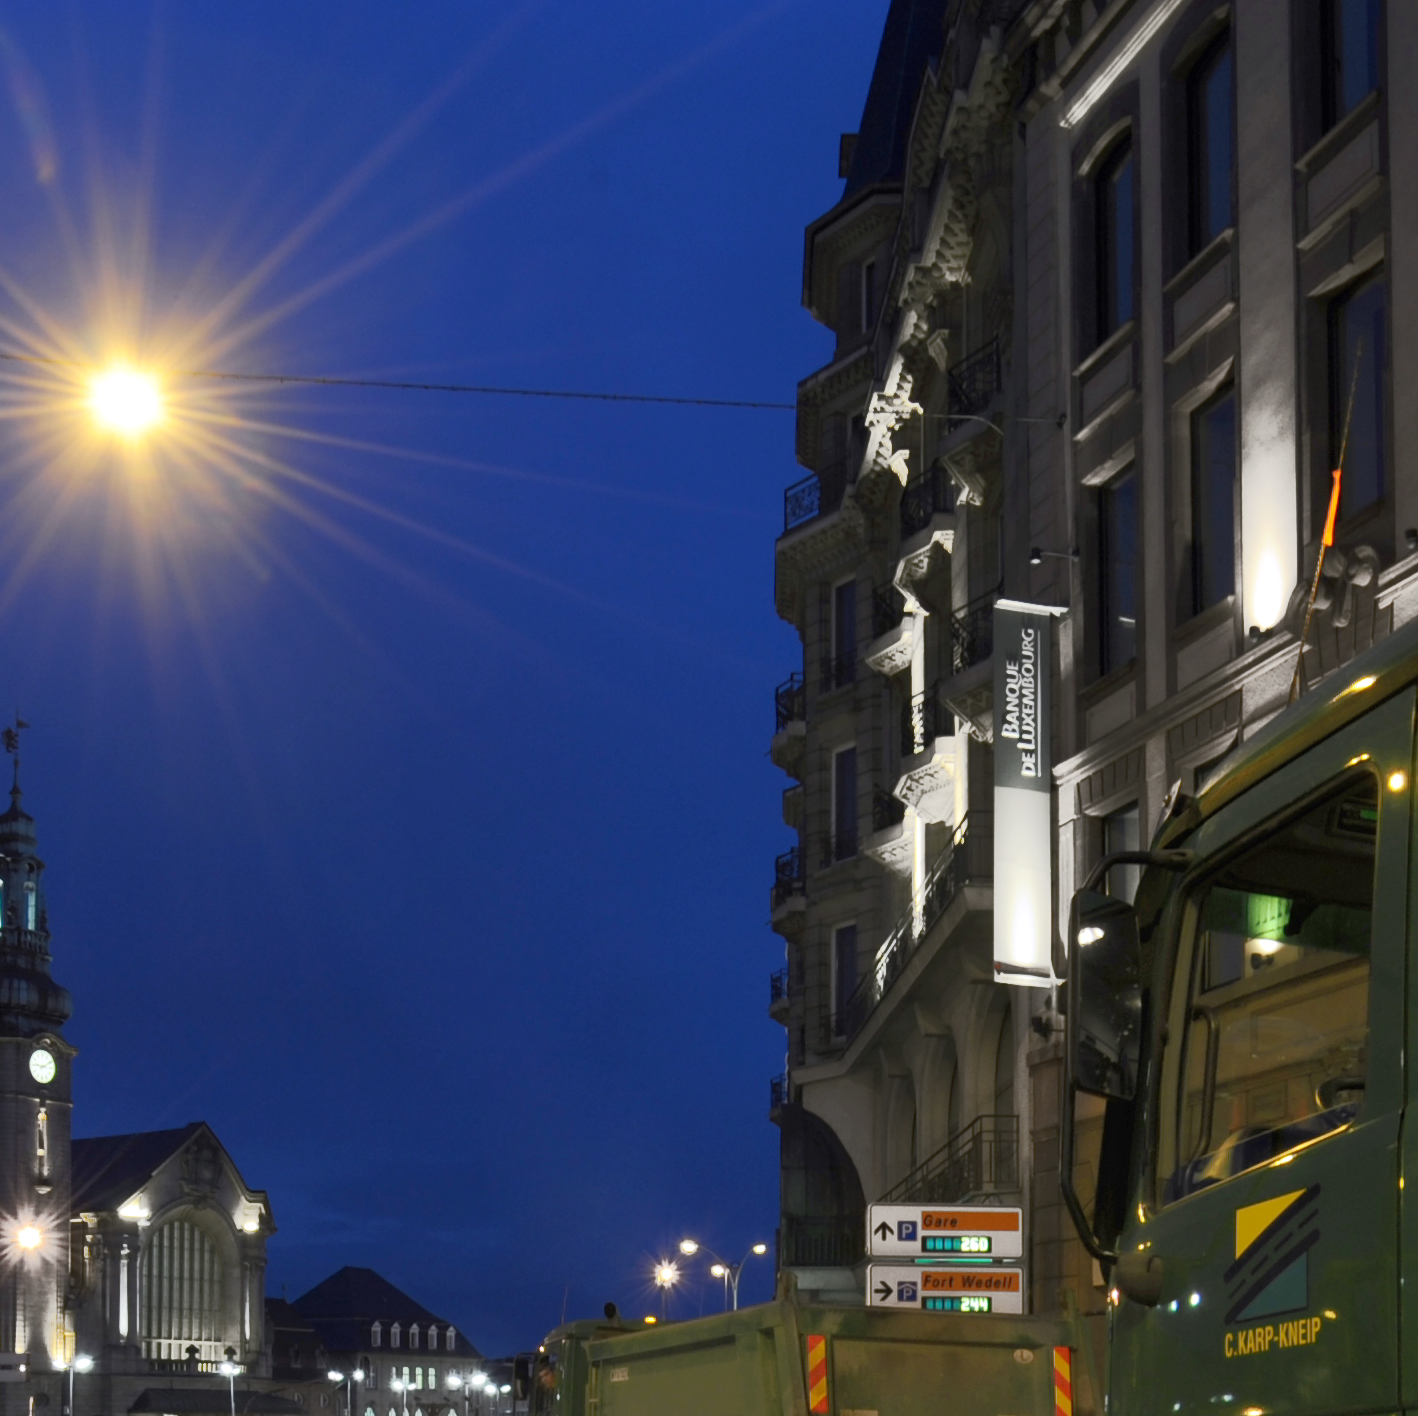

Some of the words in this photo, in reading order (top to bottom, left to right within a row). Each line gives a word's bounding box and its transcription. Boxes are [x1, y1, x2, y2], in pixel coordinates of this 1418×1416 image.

[1017, 628, 1035, 749] LUXEMBOURG
[1001, 660, 1022, 738] BANQUE
[1021, 752, 1036, 776] DE
[923, 1214, 958, 1228] Gare
[960, 1236, 989, 1252] 260
[923, 1274, 954, 1288] Fort
[962, 1274, 1013, 1289] Wedell
[960, 1296, 989, 1312] 244
[1224, 1317, 1321, 1358] C.KARP-KNEIP
